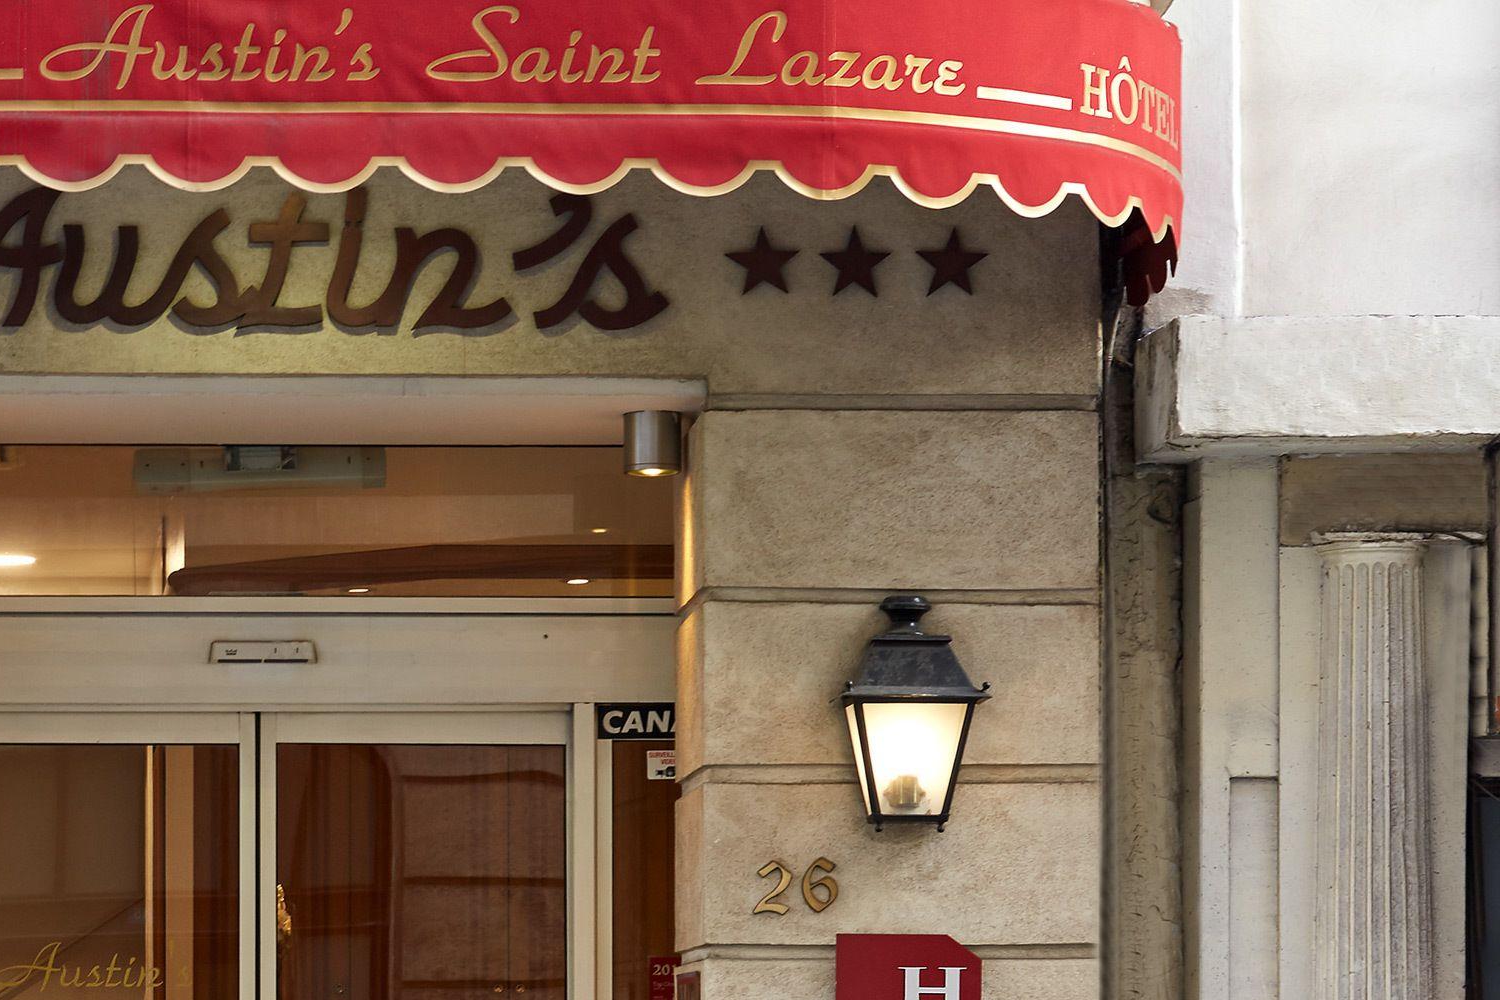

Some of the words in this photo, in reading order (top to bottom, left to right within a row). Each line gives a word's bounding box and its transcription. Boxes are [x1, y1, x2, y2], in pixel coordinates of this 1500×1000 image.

[40, 3, 382, 91] Austin's
[426, 6, 661, 84] Saint
[698, 10, 966, 98] Lazare
[1080, 56, 1180, 150] HÔTEL
[752, 857, 839, 916] 26
